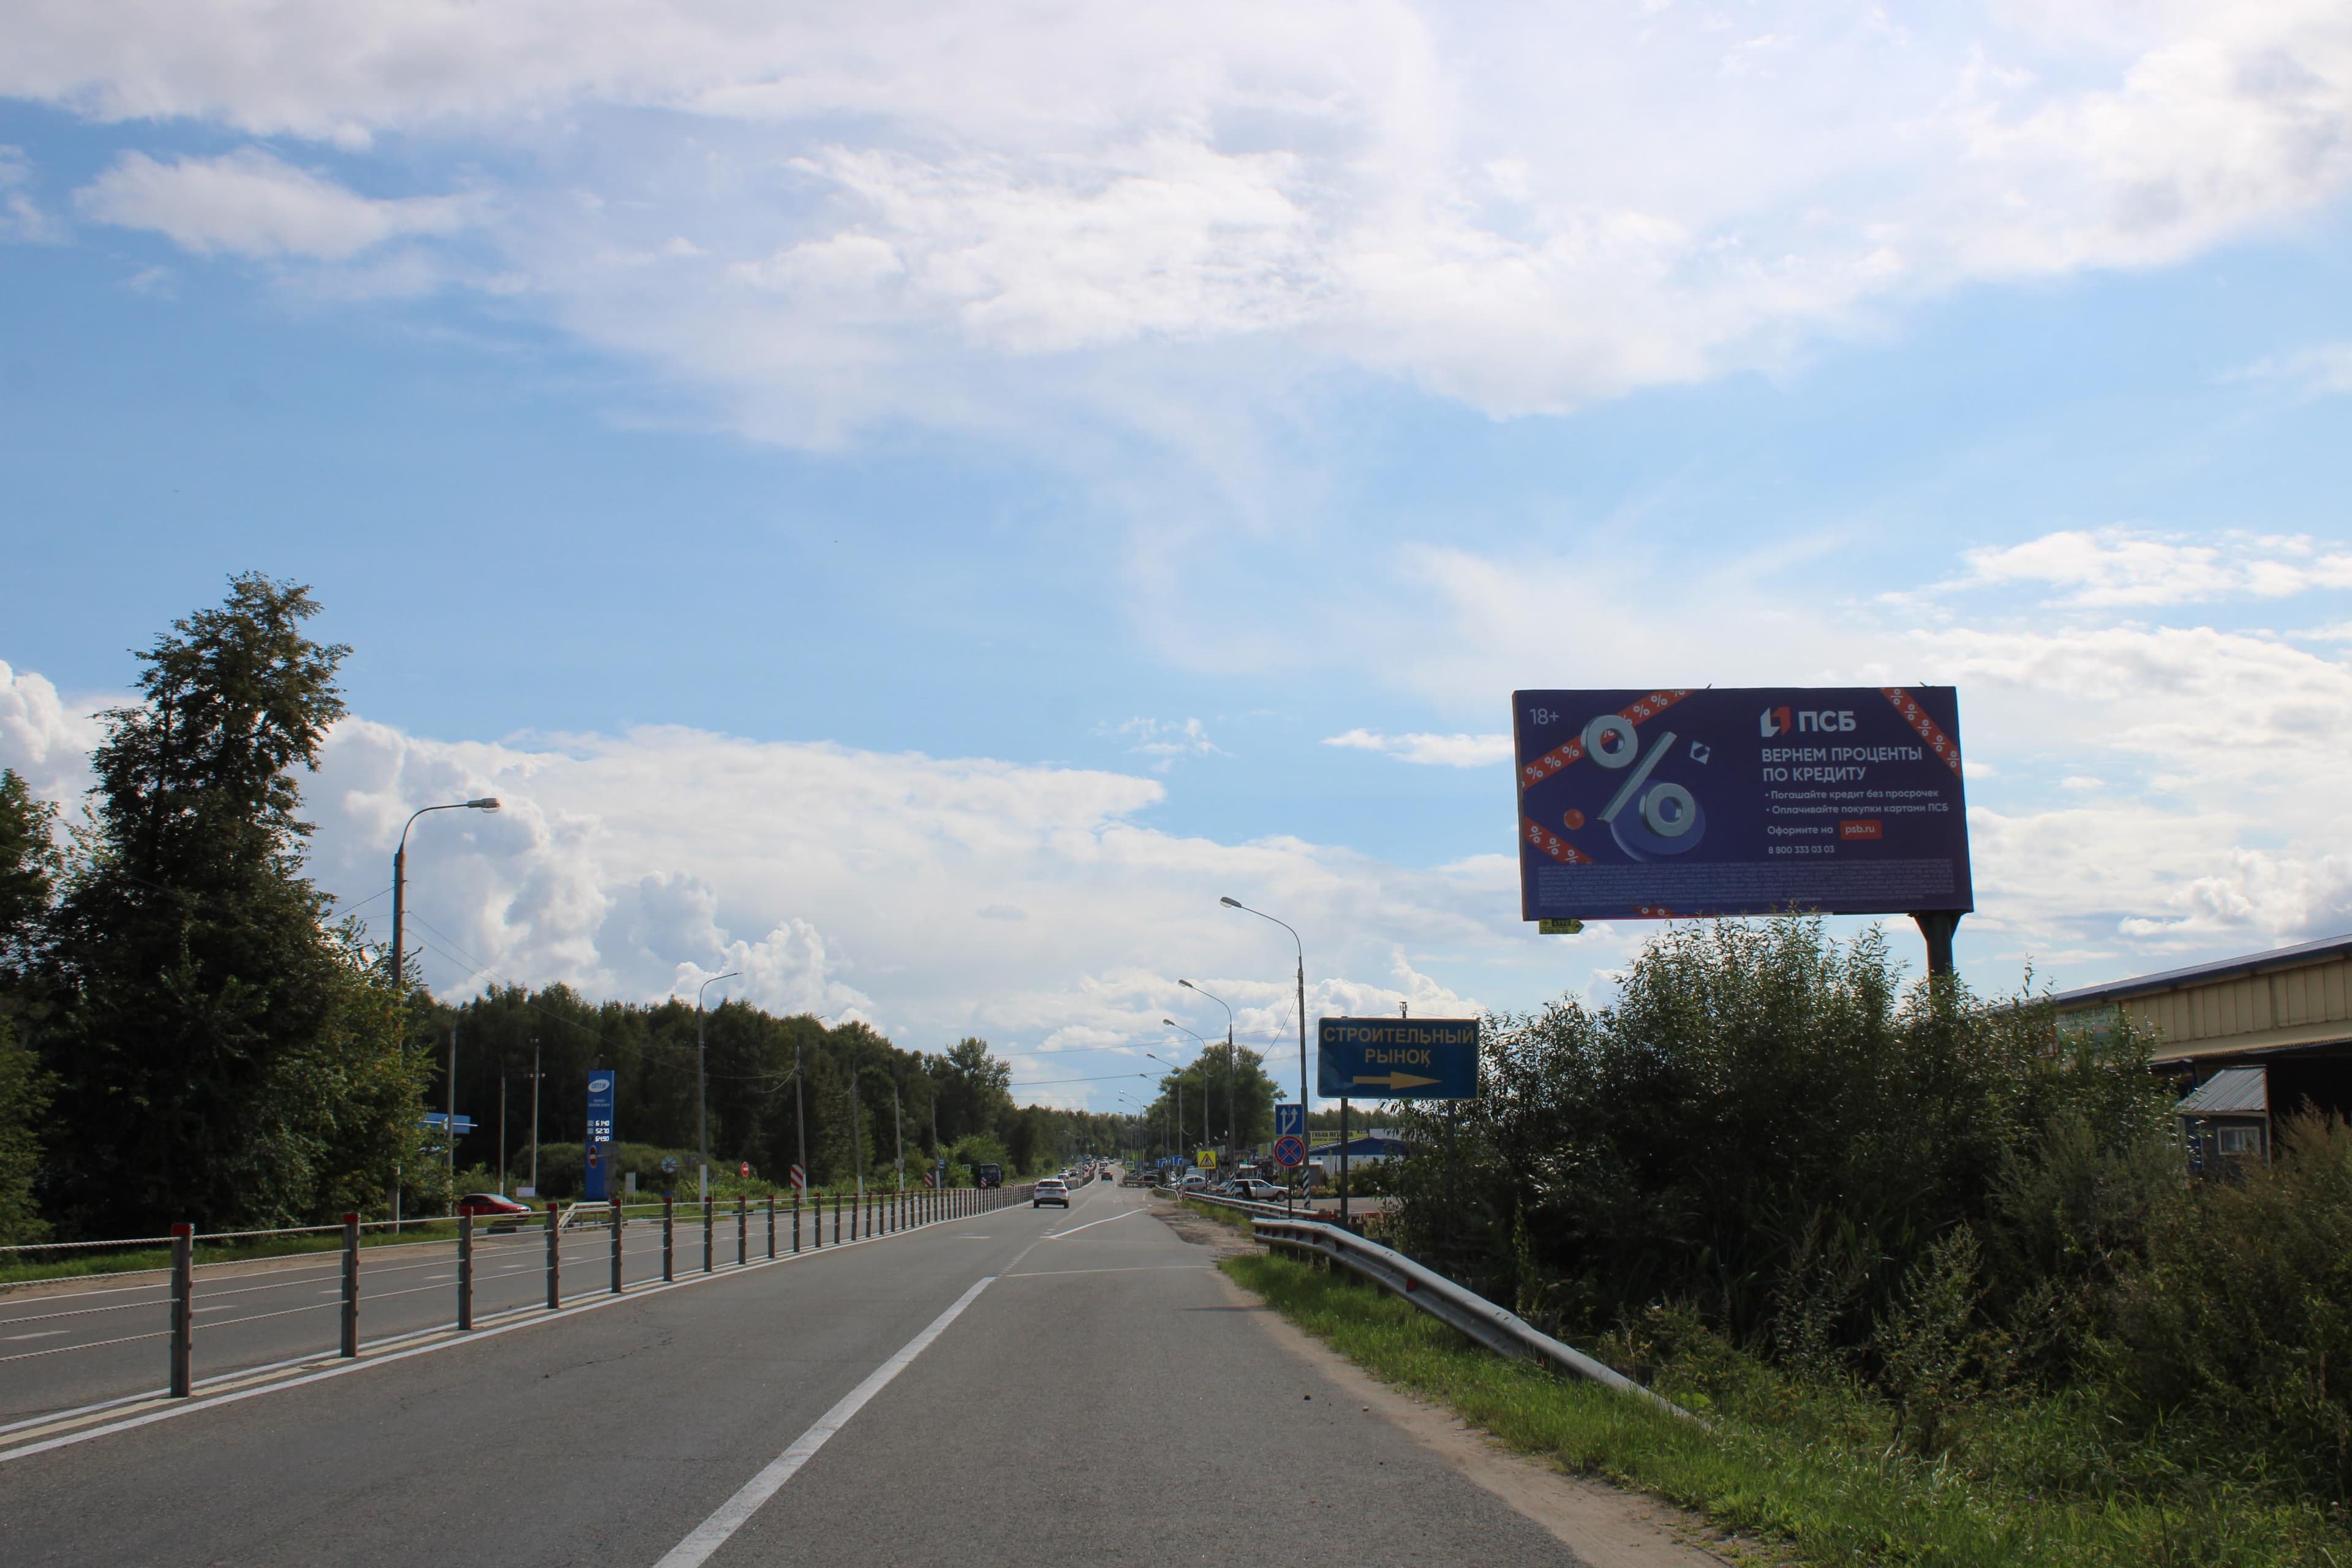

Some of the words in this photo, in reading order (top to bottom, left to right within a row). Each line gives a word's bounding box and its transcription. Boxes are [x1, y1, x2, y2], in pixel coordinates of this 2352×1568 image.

[1529, 709, 1559, 725] 18+
[1798, 710, 1856, 732] ПСБ
[1762, 747, 1826, 762] ВЕРНЕМ
[1831, 747, 1923, 763] ПРОЦЕНТЫ
[1763, 767, 1788, 782] ПО
[1793, 766, 1866, 783] КРЕДИТУ
[1771, 790, 1826, 799] Погашайте
[1829, 791, 1864, 800] кредит
[1866, 790, 1884, 798] без
[1886, 790, 1939, 799] просрочек
[1772, 805, 1839, 814] Оплачивайте
[1841, 806, 1880, 815] покупки
[1883, 805, 1926, 814] картами
[1928, 803, 1949, 812] ПСБ
[1767, 826, 1819, 836] Оформите
[1845, 825, 1875, 835] psb.ru
[1324, 1027, 1474, 1044] СТРОИТЕЛЬНЫЙ
[1365, 1049, 1431, 1065] РЫНОК
